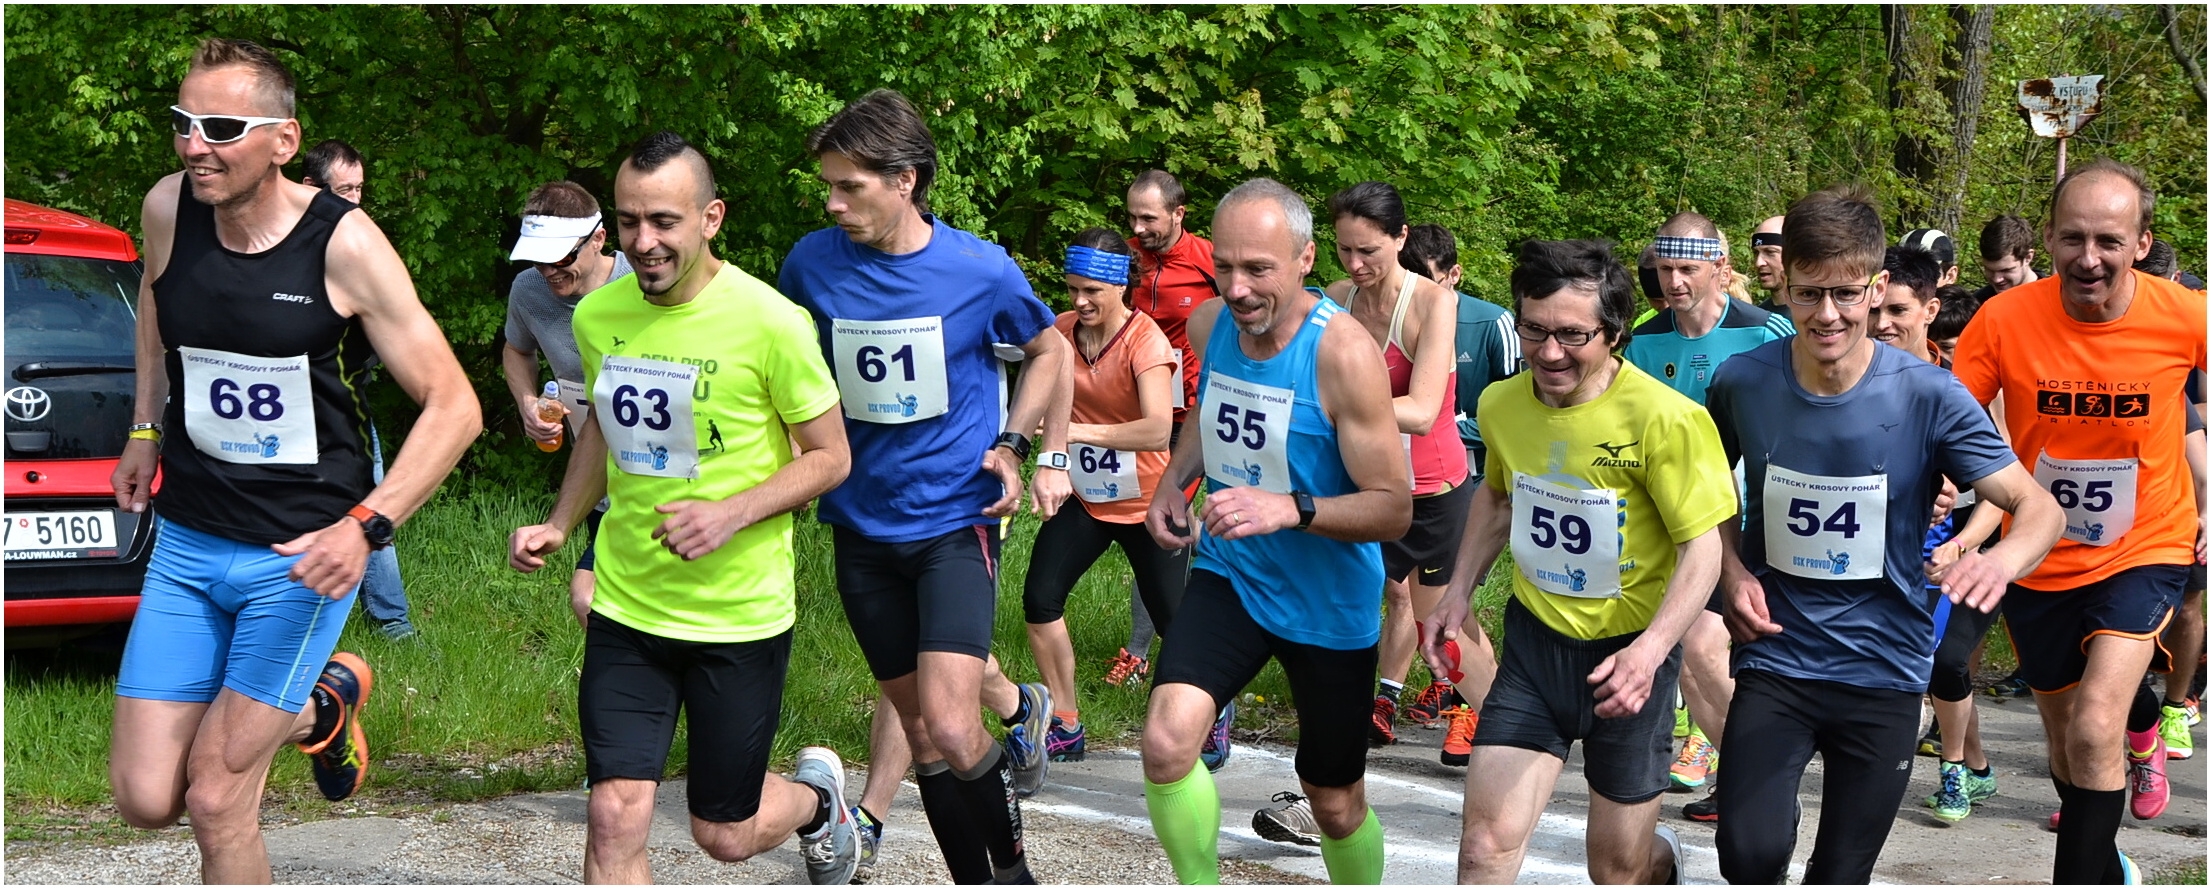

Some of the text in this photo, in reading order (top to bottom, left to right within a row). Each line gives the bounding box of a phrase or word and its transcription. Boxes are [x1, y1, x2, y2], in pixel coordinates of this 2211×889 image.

[273, 293, 304, 303] CRAFT
[871, 328, 907, 336] KROSOVÝ
[910, 326, 936, 334] POHÁR
[856, 344, 915, 383] 61
[633, 366, 666, 378] KROSOVÝ
[667, 370, 691, 380] POHÁR
[2036, 378, 2151, 391] HOSTĚNICKÝ
[210, 377, 284, 422] 68
[612, 384, 672, 431] 63
[1216, 402, 1266, 451] 55
[2036, 415, 2150, 427] TRIATLON
[1080, 446, 1121, 474] 64
[1591, 456, 1639, 468] MIZUNO
[2107, 464, 2132, 472] POHÁR
[1771, 474, 1880, 492] ÚSTECKÝ KROSOVÝ POHÁR
[1546, 492, 1579, 505] KROSOVÝ
[1581, 498, 1610, 506] POHÁR
[2051, 478, 2113, 513] 65
[1786, 497, 1861, 539] 54
[36, 515, 102, 545] 5160
[1530, 505, 1592, 555] 59
[1619, 559, 1636, 574] 014
